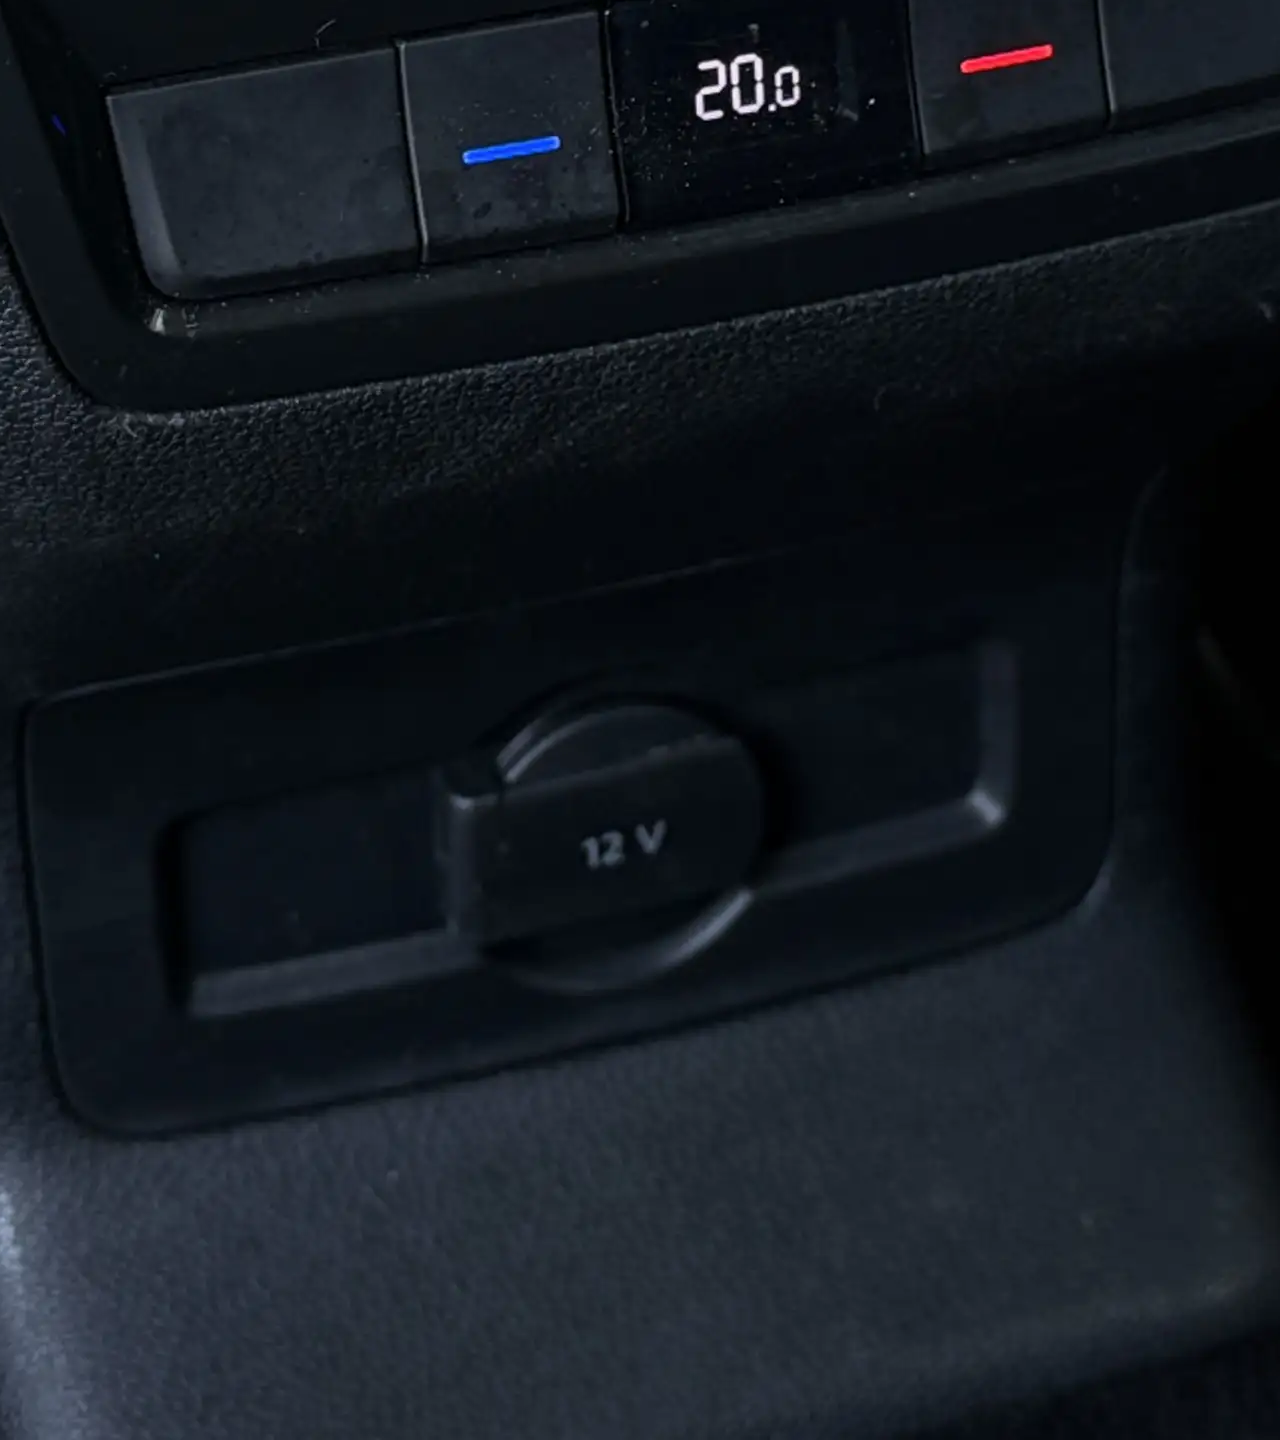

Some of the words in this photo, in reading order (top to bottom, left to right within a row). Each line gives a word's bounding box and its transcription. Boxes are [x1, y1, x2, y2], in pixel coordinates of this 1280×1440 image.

[694, 52, 802, 121] 20.0
[580, 830, 626, 871] 12
[634, 817, 668, 855] V
